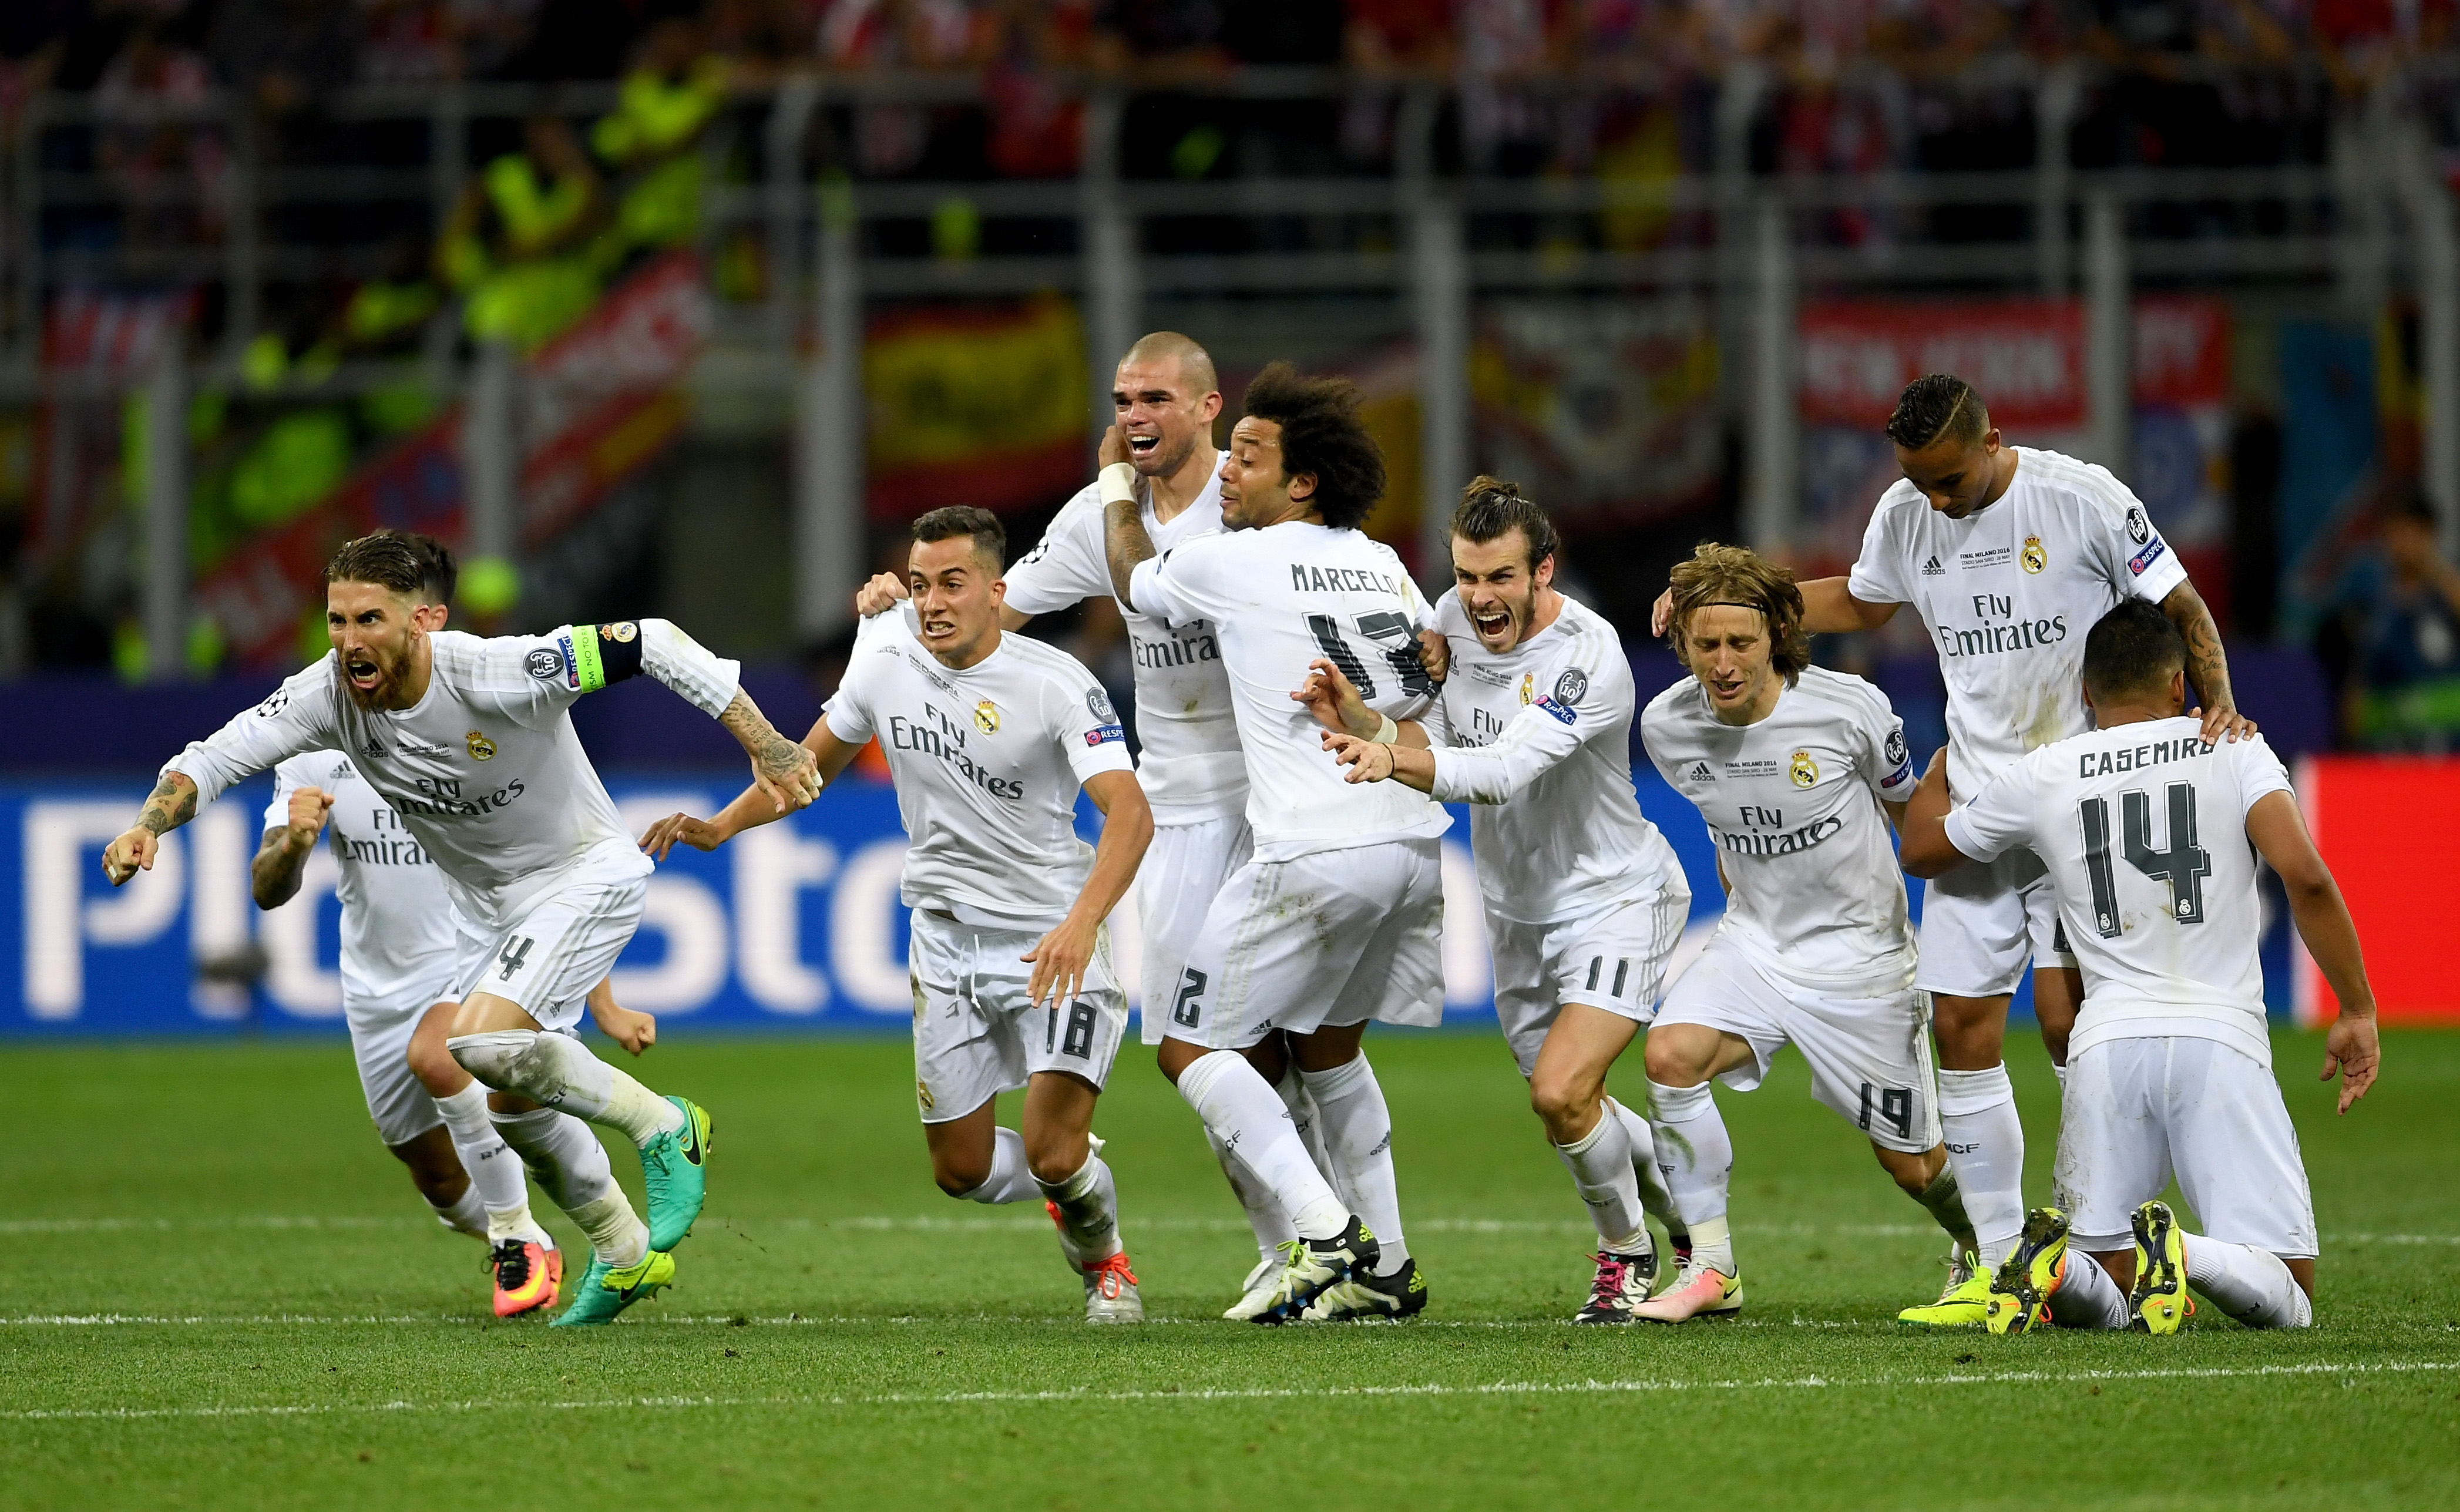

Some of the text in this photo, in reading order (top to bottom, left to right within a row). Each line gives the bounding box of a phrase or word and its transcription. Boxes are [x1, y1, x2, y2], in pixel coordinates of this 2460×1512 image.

[2141, 539, 2163, 564] RESPEC
[1972, 593, 2012, 619] Fly
[1132, 632, 1221, 668] Emira
[1937, 615, 2066, 658] Emirates
[1561, 685, 1576, 698] 10
[923, 701, 966, 748] Fly
[1099, 705, 1111, 716] 10
[1100, 729, 1125, 739] RESPE
[415, 778, 461, 798] Fly
[1690, 774, 1716, 782] adidas
[1739, 805, 1783, 829] Fly
[337, 832, 433, 866] Emira
[2077, 779, 2212, 939] 14
[499, 933, 535, 982] 4
[1585, 954, 1629, 999] 11
[1046, 999, 1098, 1060] 18
[1859, 1080, 1913, 1140] 19
[1225, 1129, 1242, 1152] CF
